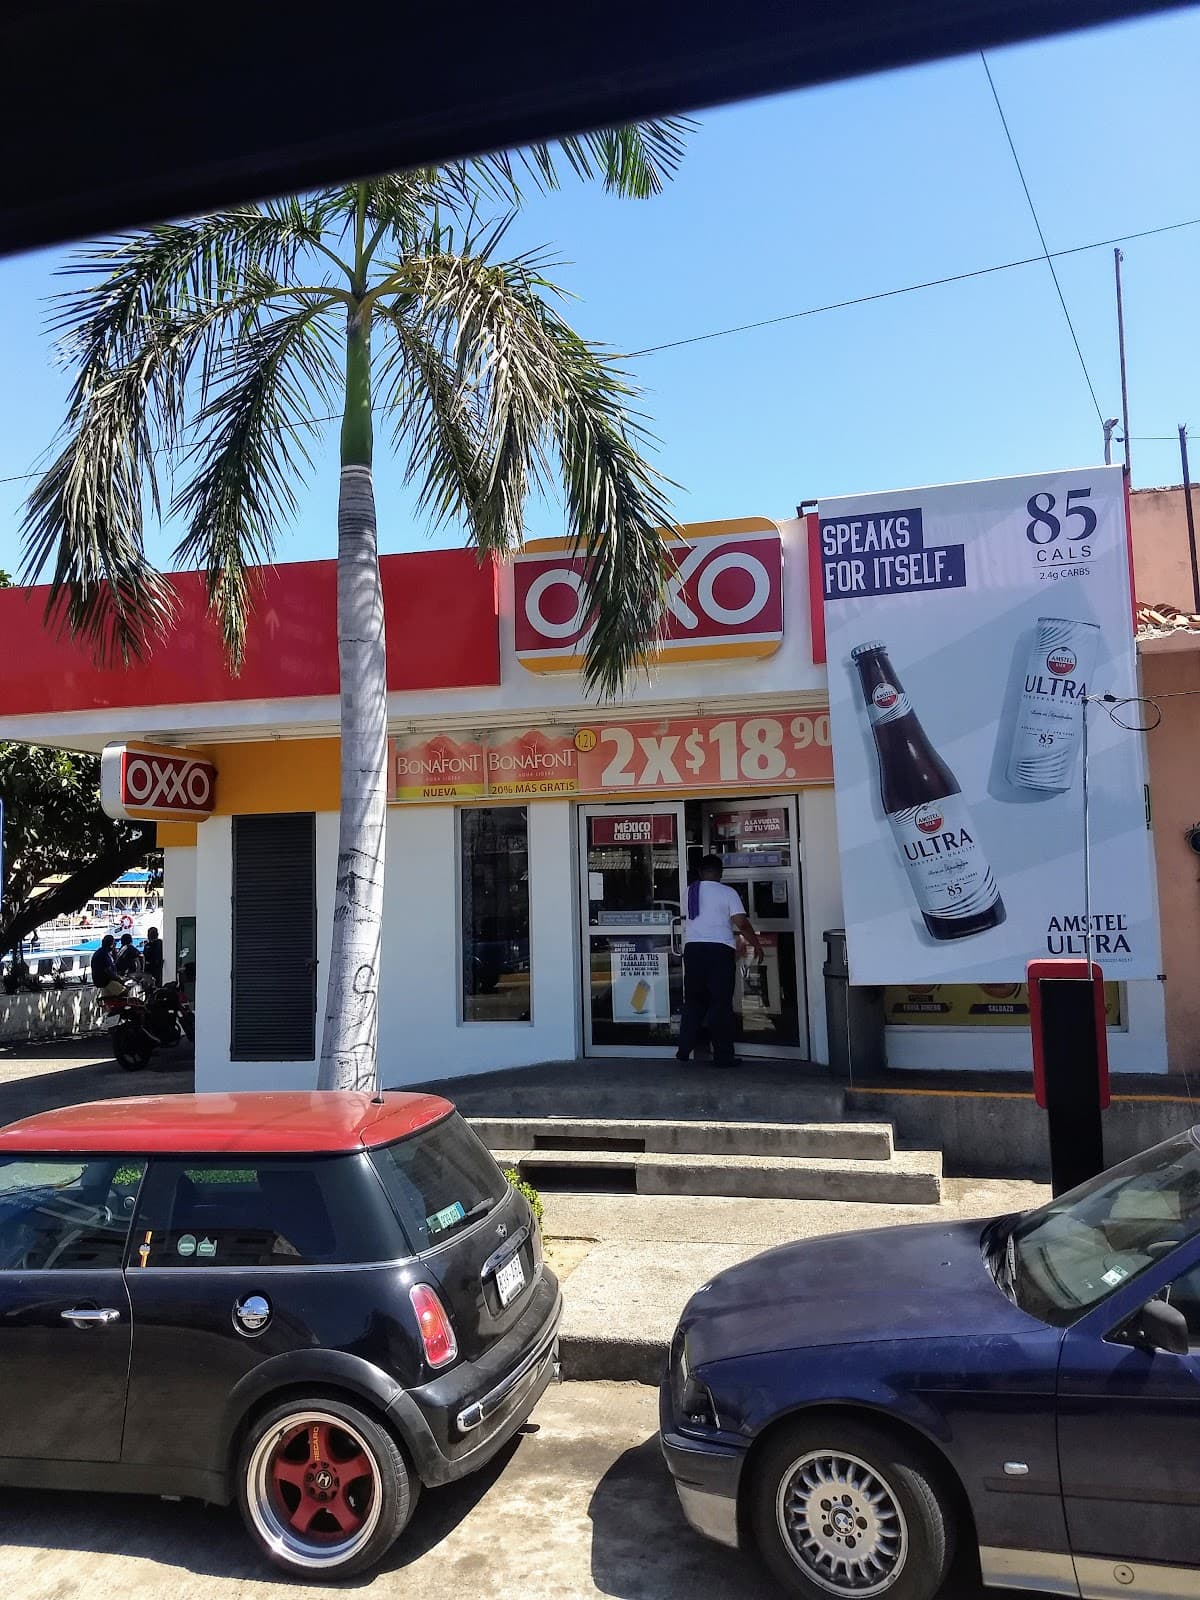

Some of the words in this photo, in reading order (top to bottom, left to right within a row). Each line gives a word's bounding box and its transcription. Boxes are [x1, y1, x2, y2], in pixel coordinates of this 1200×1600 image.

[1026, 487, 1097, 545] 85
[822, 516, 910, 556] SPEAKS
[1036, 545, 1091, 562] CALS
[824, 559, 867, 594] FOR
[873, 550, 953, 589] ITSELF.
[1039, 571, 1058, 580] 2.4g
[1060, 567, 1090, 577] CARBS
[1024, 674, 1087, 699] ULTRA
[1038, 733, 1054, 745] 85
[397, 754, 481, 775] BONAFONT
[489, 748, 576, 771] BONAFONT
[126, 759, 210, 807] OXXO
[423, 786, 457, 798] NUEVA
[491, 785, 513, 795] 20%
[515, 783, 537, 794] MÁS
[539, 781, 575, 792] GRATIS
[614, 819, 651, 833] MÉXICO
[613, 832, 631, 841] CREO
[632, 832, 642, 840] EN
[644, 832, 651, 840] TI
[903, 827, 973, 861] ULTRA
[947, 882, 963, 897] 85
[1047, 914, 1128, 932] AMSTEL
[1046, 933, 1132, 954] ULTRA
[647, 953, 659, 961] TUS
